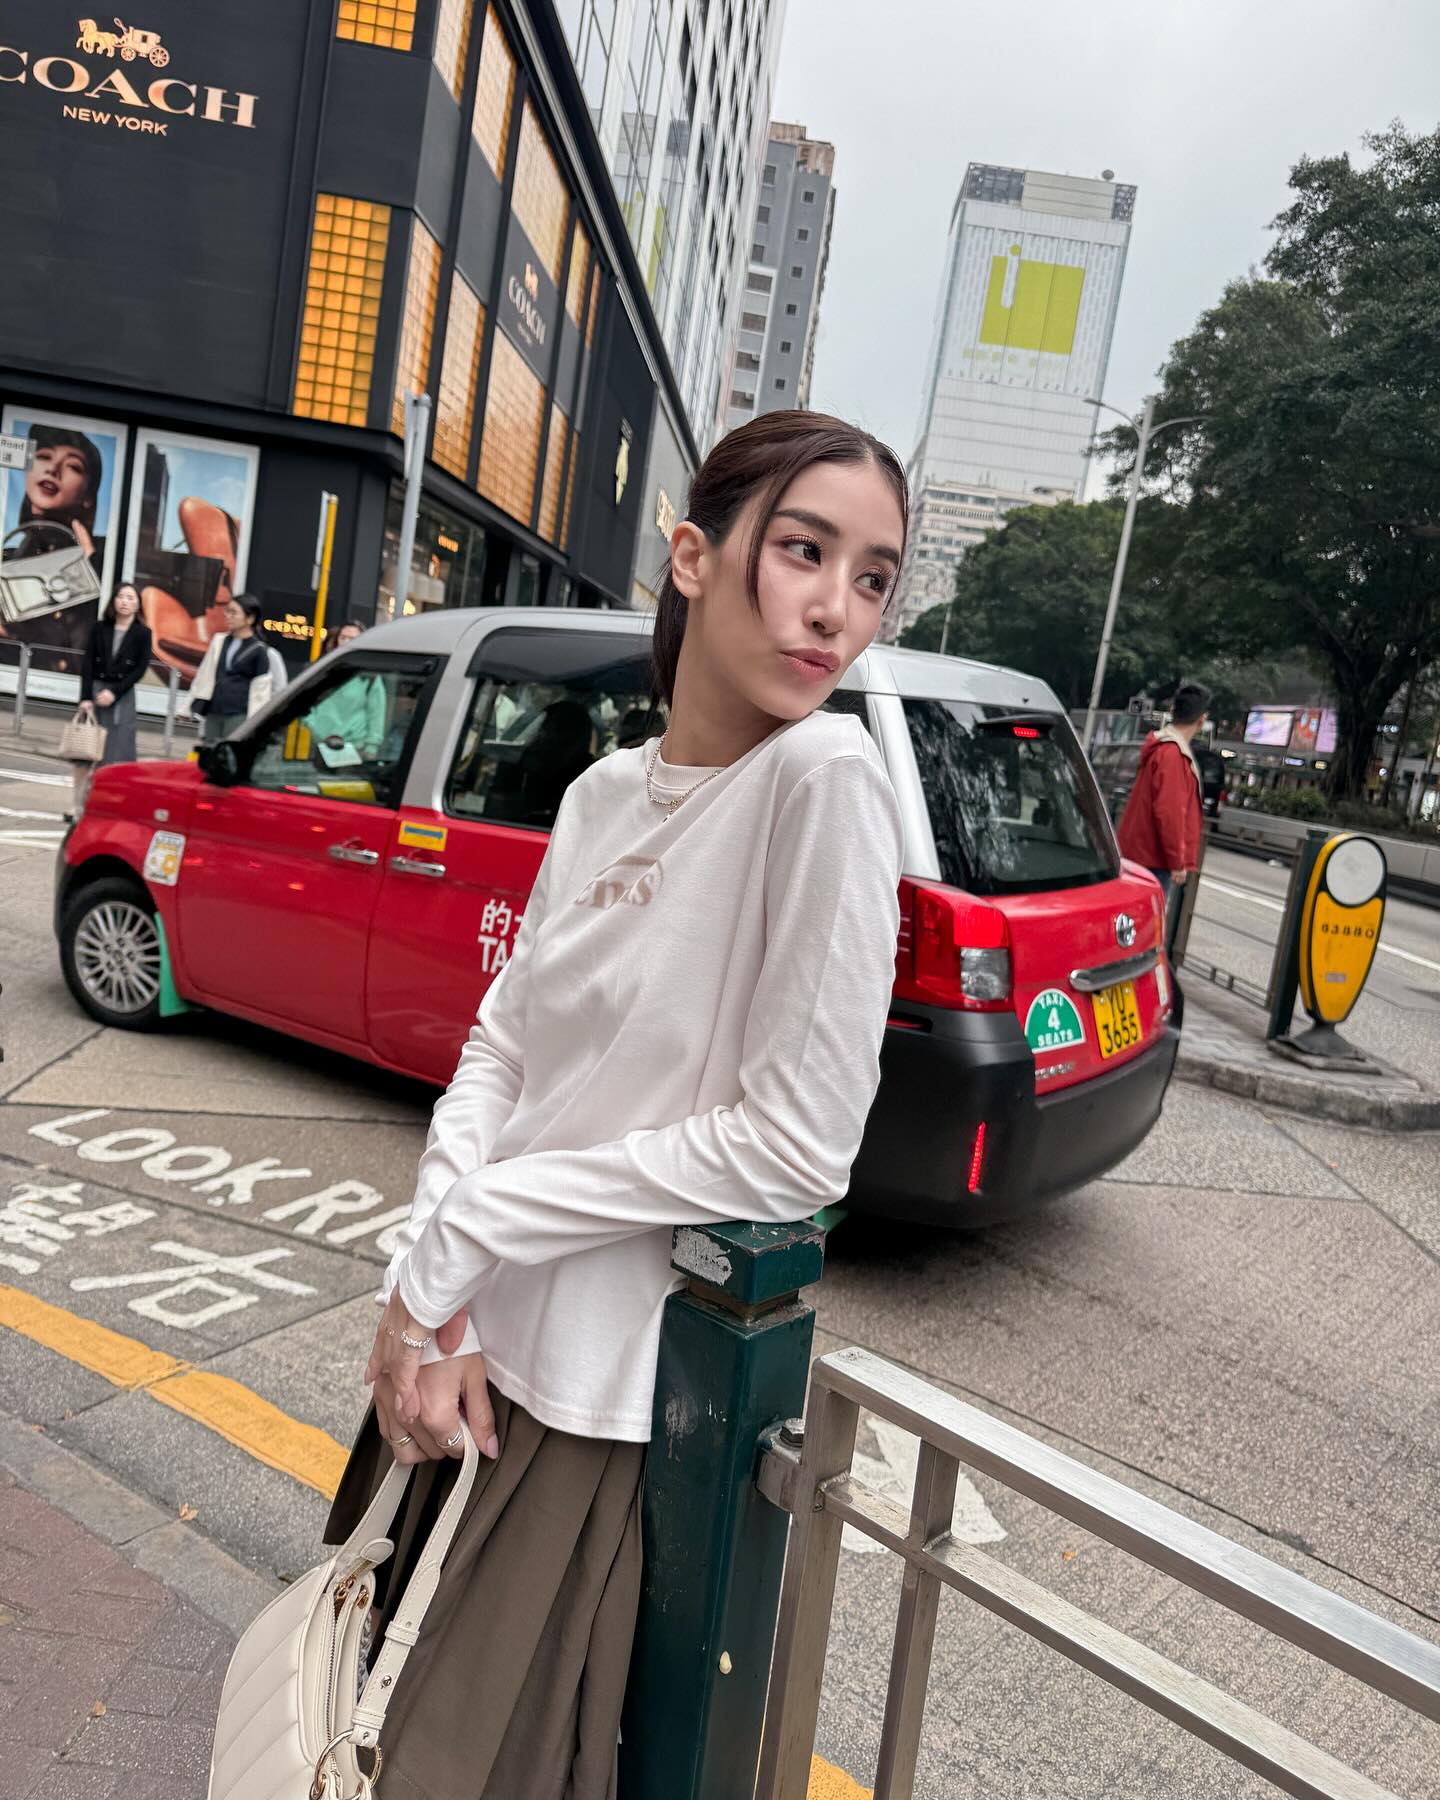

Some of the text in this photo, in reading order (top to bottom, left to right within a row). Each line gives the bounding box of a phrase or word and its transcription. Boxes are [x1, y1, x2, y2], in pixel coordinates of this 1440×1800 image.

[0, 46, 260, 129] COACH
[63, 104, 169, 137] NEW YORK
[508, 275, 546, 345] COACH
[480, 898, 525, 942] 的
[478, 934, 509, 976] TA
[1038, 991, 1065, 1009] TAXI
[1047, 1007, 1061, 1030] 4
[1037, 1028, 1074, 1048] SEATS
[1102, 1013, 1139, 1054] 3655
[27, 1108, 313, 1206] LOOK
